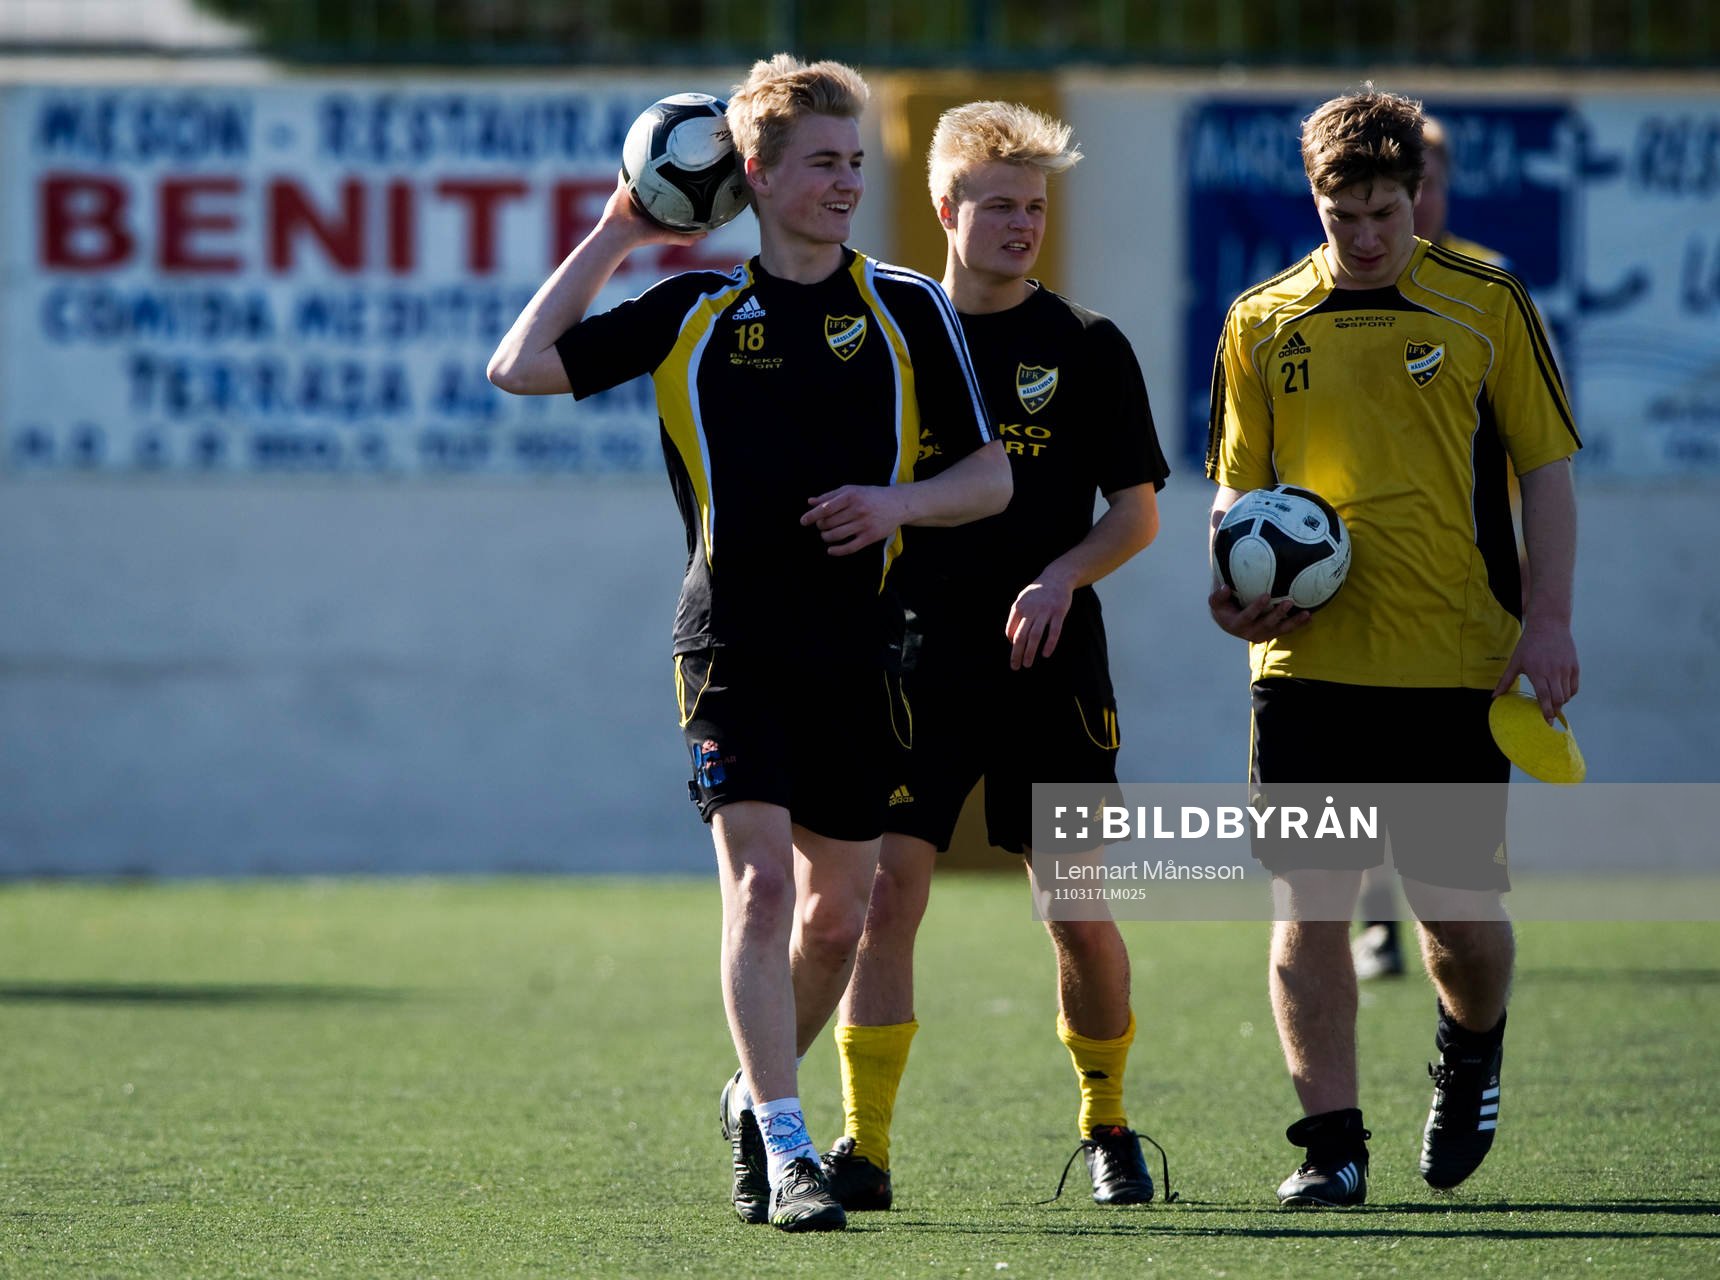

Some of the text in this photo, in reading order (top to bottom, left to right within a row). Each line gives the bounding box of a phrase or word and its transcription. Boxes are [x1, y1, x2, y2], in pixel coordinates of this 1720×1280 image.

[318, 93, 629, 163] RESTAURA
[732, 309, 766, 321] adidas
[1334, 315, 1396, 323] BAREKO
[829, 321, 848, 329] IFK
[734, 323, 765, 351] 18
[1278, 345, 1312, 359] adidas
[1408, 345, 1427, 355] IFK
[1020, 370, 1040, 380] IFK
[1281, 358, 1310, 394] 21
